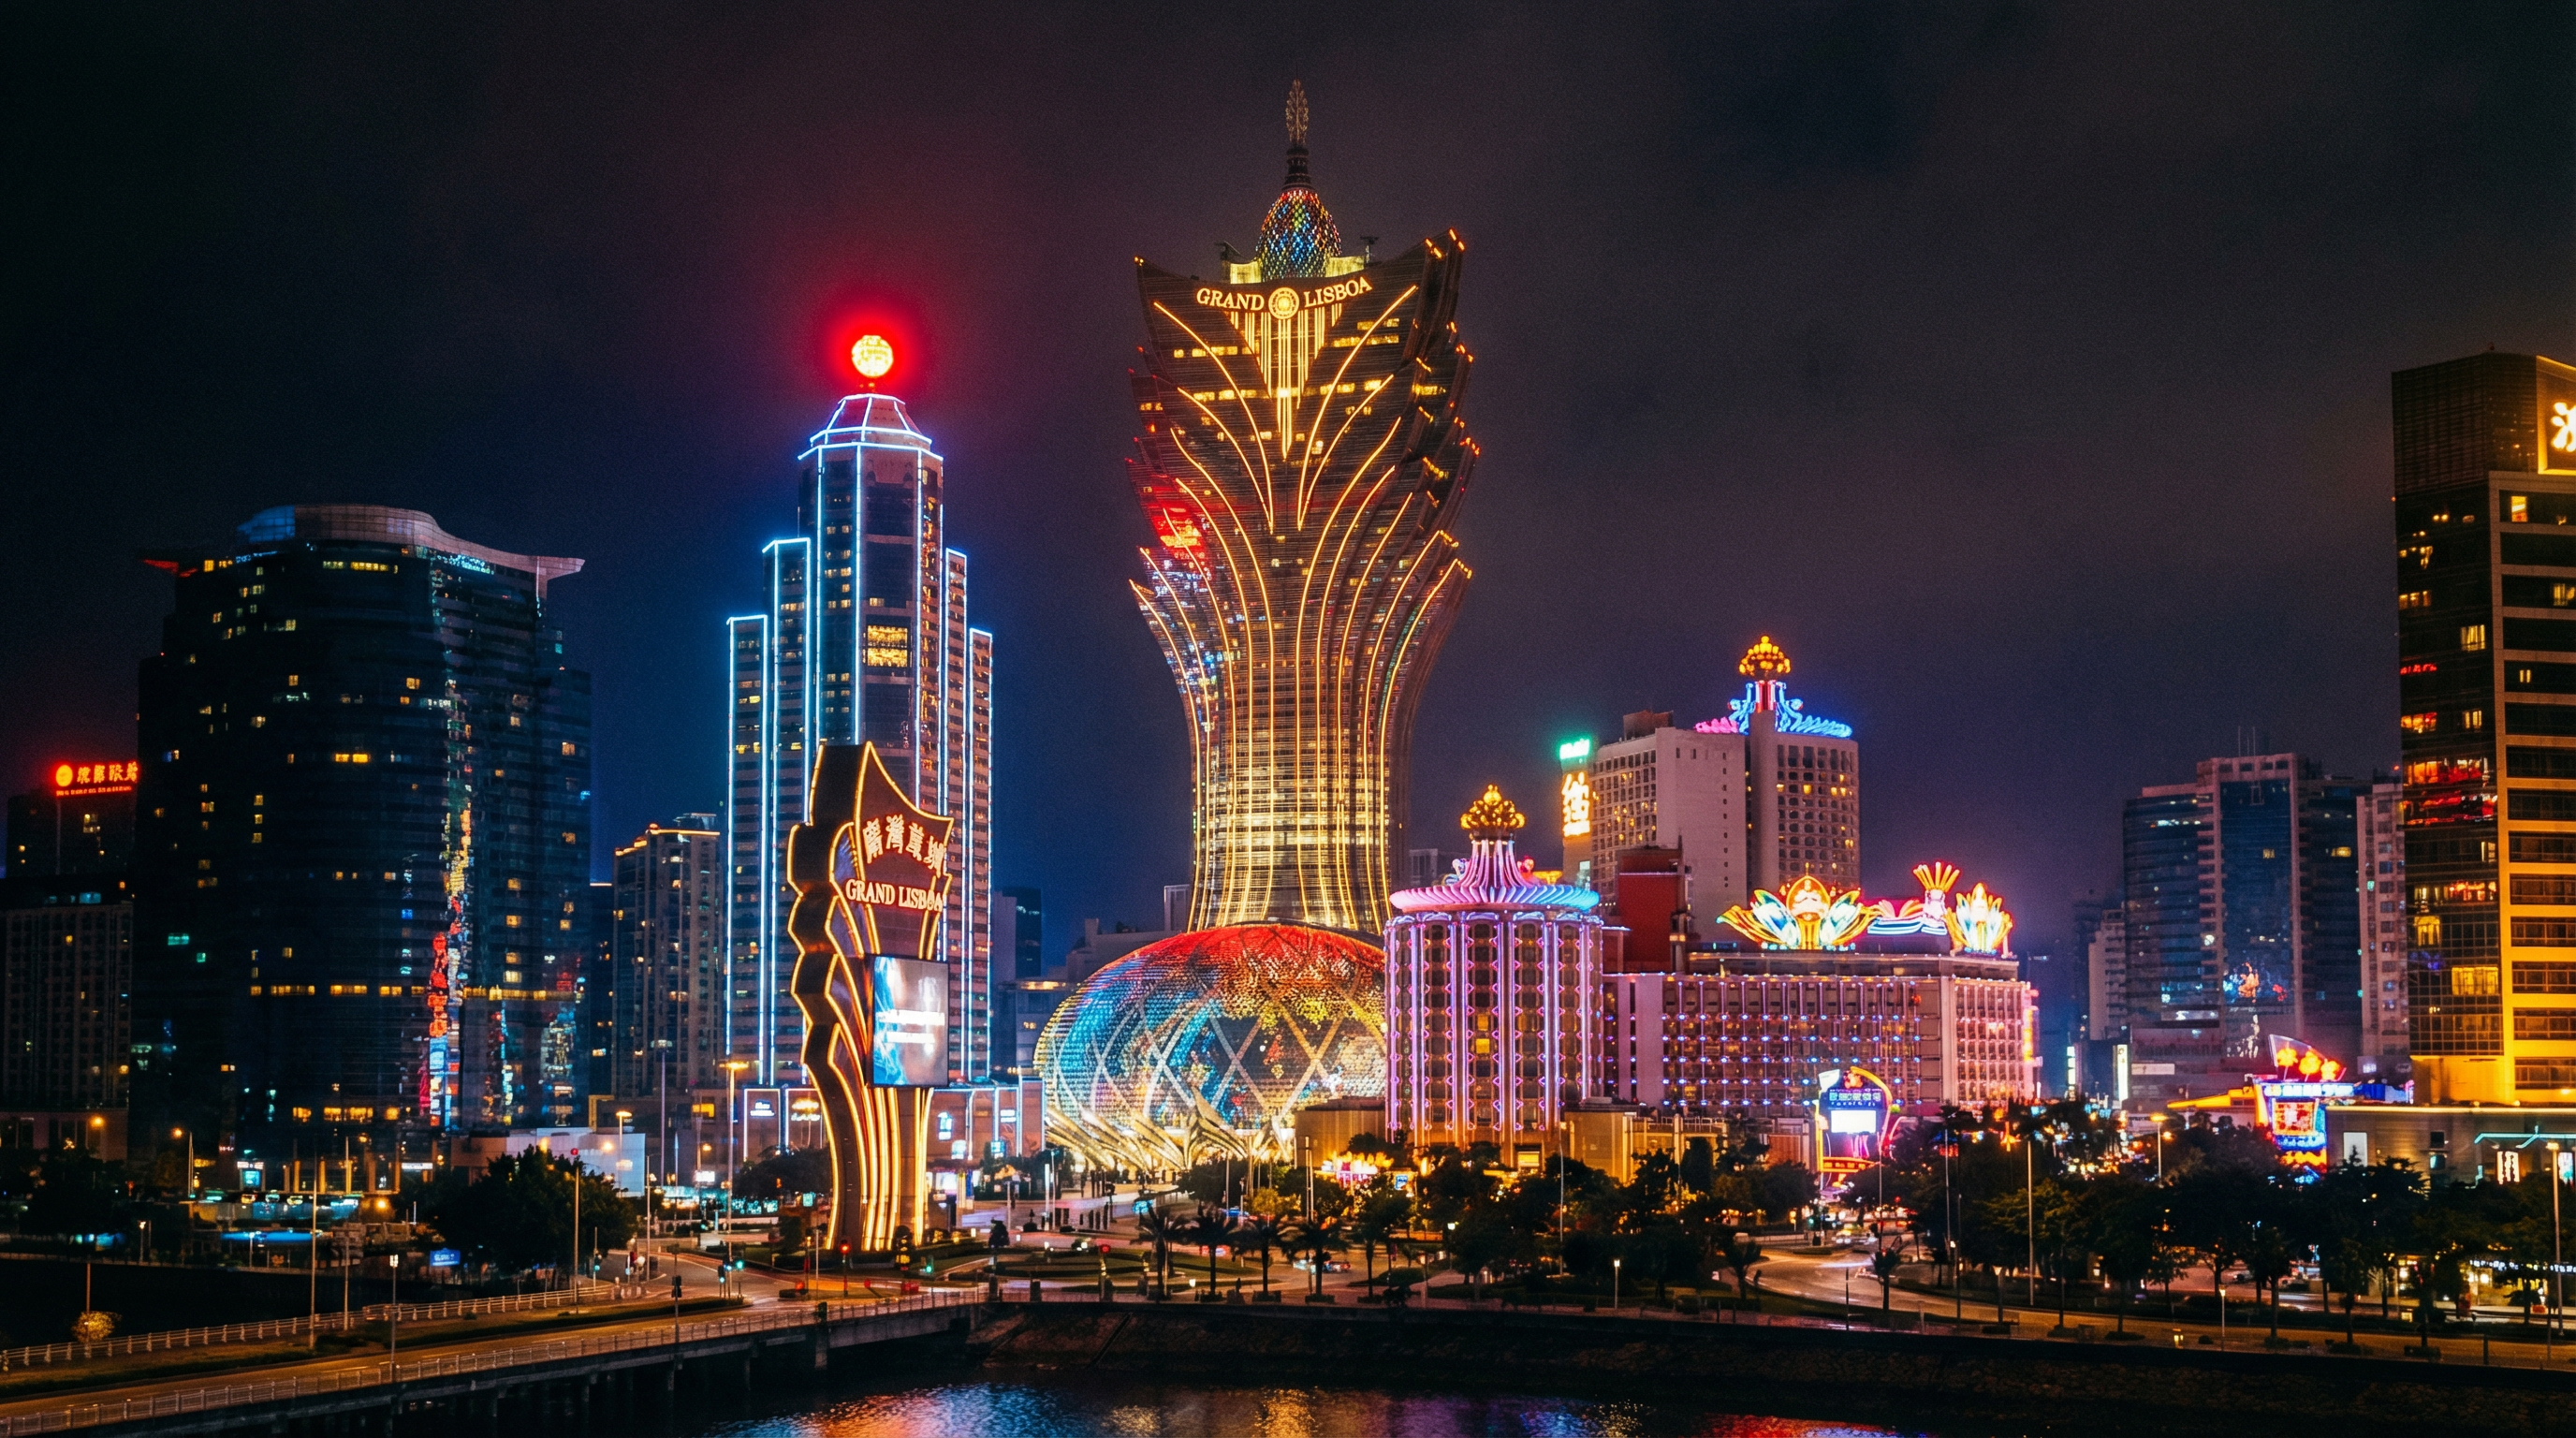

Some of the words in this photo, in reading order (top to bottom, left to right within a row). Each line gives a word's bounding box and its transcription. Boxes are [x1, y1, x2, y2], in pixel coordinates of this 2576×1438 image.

[1196, 287, 1265, 311] GRAND
[1304, 276, 1373, 308] LISBOA
[845, 878, 896, 905] GRAND
[899, 886, 944, 912] LISBOA
